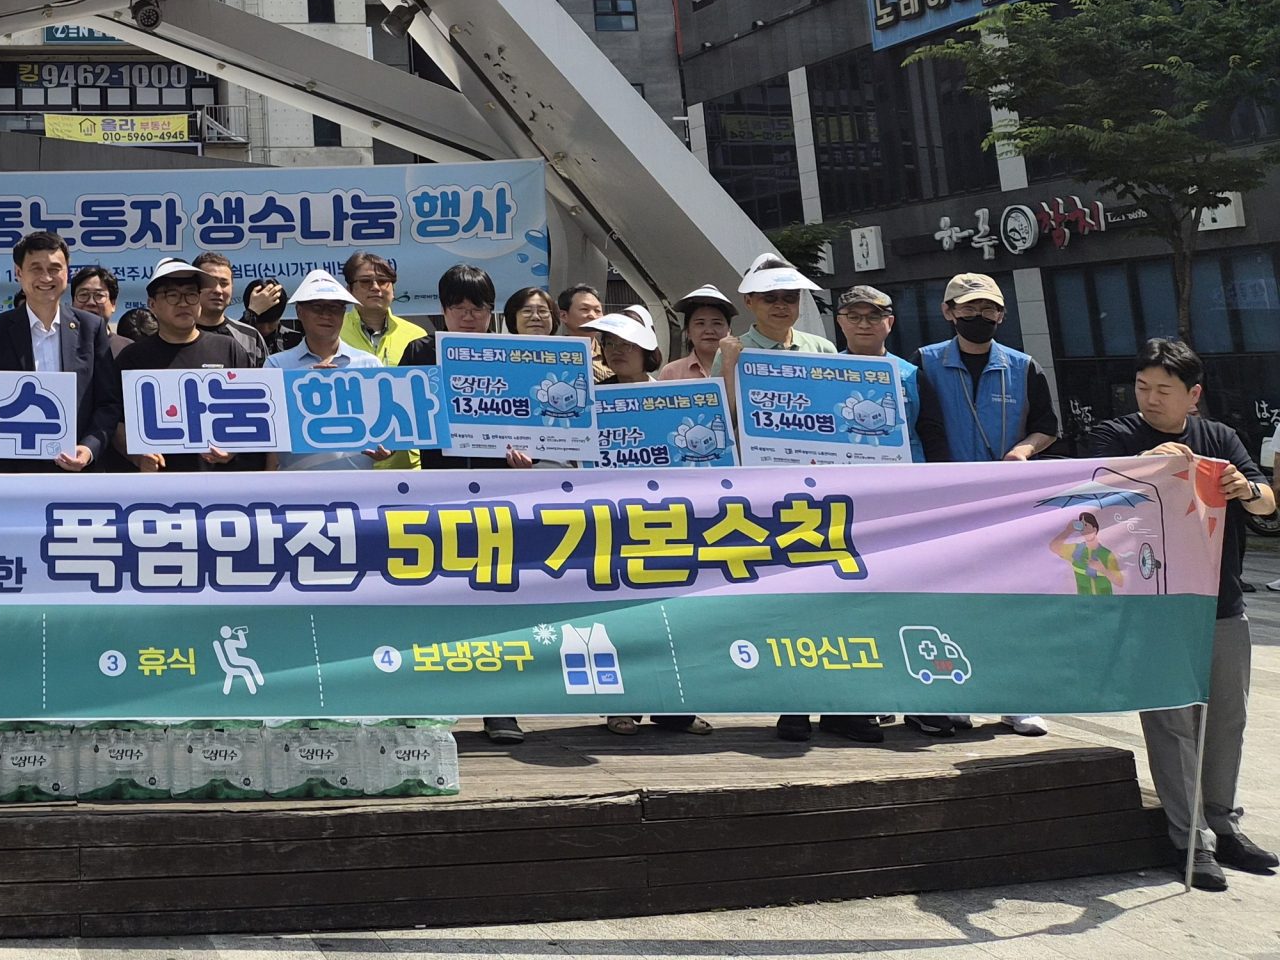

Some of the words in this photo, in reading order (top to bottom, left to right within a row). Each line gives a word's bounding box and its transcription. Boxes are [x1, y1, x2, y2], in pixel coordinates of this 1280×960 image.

[18, 63, 39, 83] 킹
[41, 63, 188, 89] 9462-1000
[102, 130, 185, 142] 010-5960-4945
[196, 191, 399, 247] 생수나눔
[412, 186, 512, 238] 행사
[447, 347, 507, 362] 이동노동자
[509, 350, 557, 364] 생수나눔
[559, 351, 584, 365] 후원
[743, 362, 807, 379] 이동노동자
[809, 366, 861, 382] 생수나눔
[863, 370, 891, 384] 후원
[141, 371, 271, 444] 나눔
[294, 373, 436, 447] 행사
[451, 396, 531, 417] 13,440병
[641, 395, 691, 410] 생수나눔
[693, 393, 720, 406] 후원
[750, 410, 836, 434] 13,440병
[46, 506, 360, 588] 폭염안전
[384, 505, 513, 587] 5대
[540, 498, 862, 588] 기본수칙
[137, 647, 197, 678] 휴식
[412, 639, 536, 676] 보냉장구
[766, 634, 885, 672] 119신고
[17, 752, 48, 768] 삼다수
[114, 747, 144, 762] 삼다수
[208, 747, 239, 762] 삼다수
[304, 746, 335, 762] 삼다수
[400, 747, 431, 762] 삼다수
